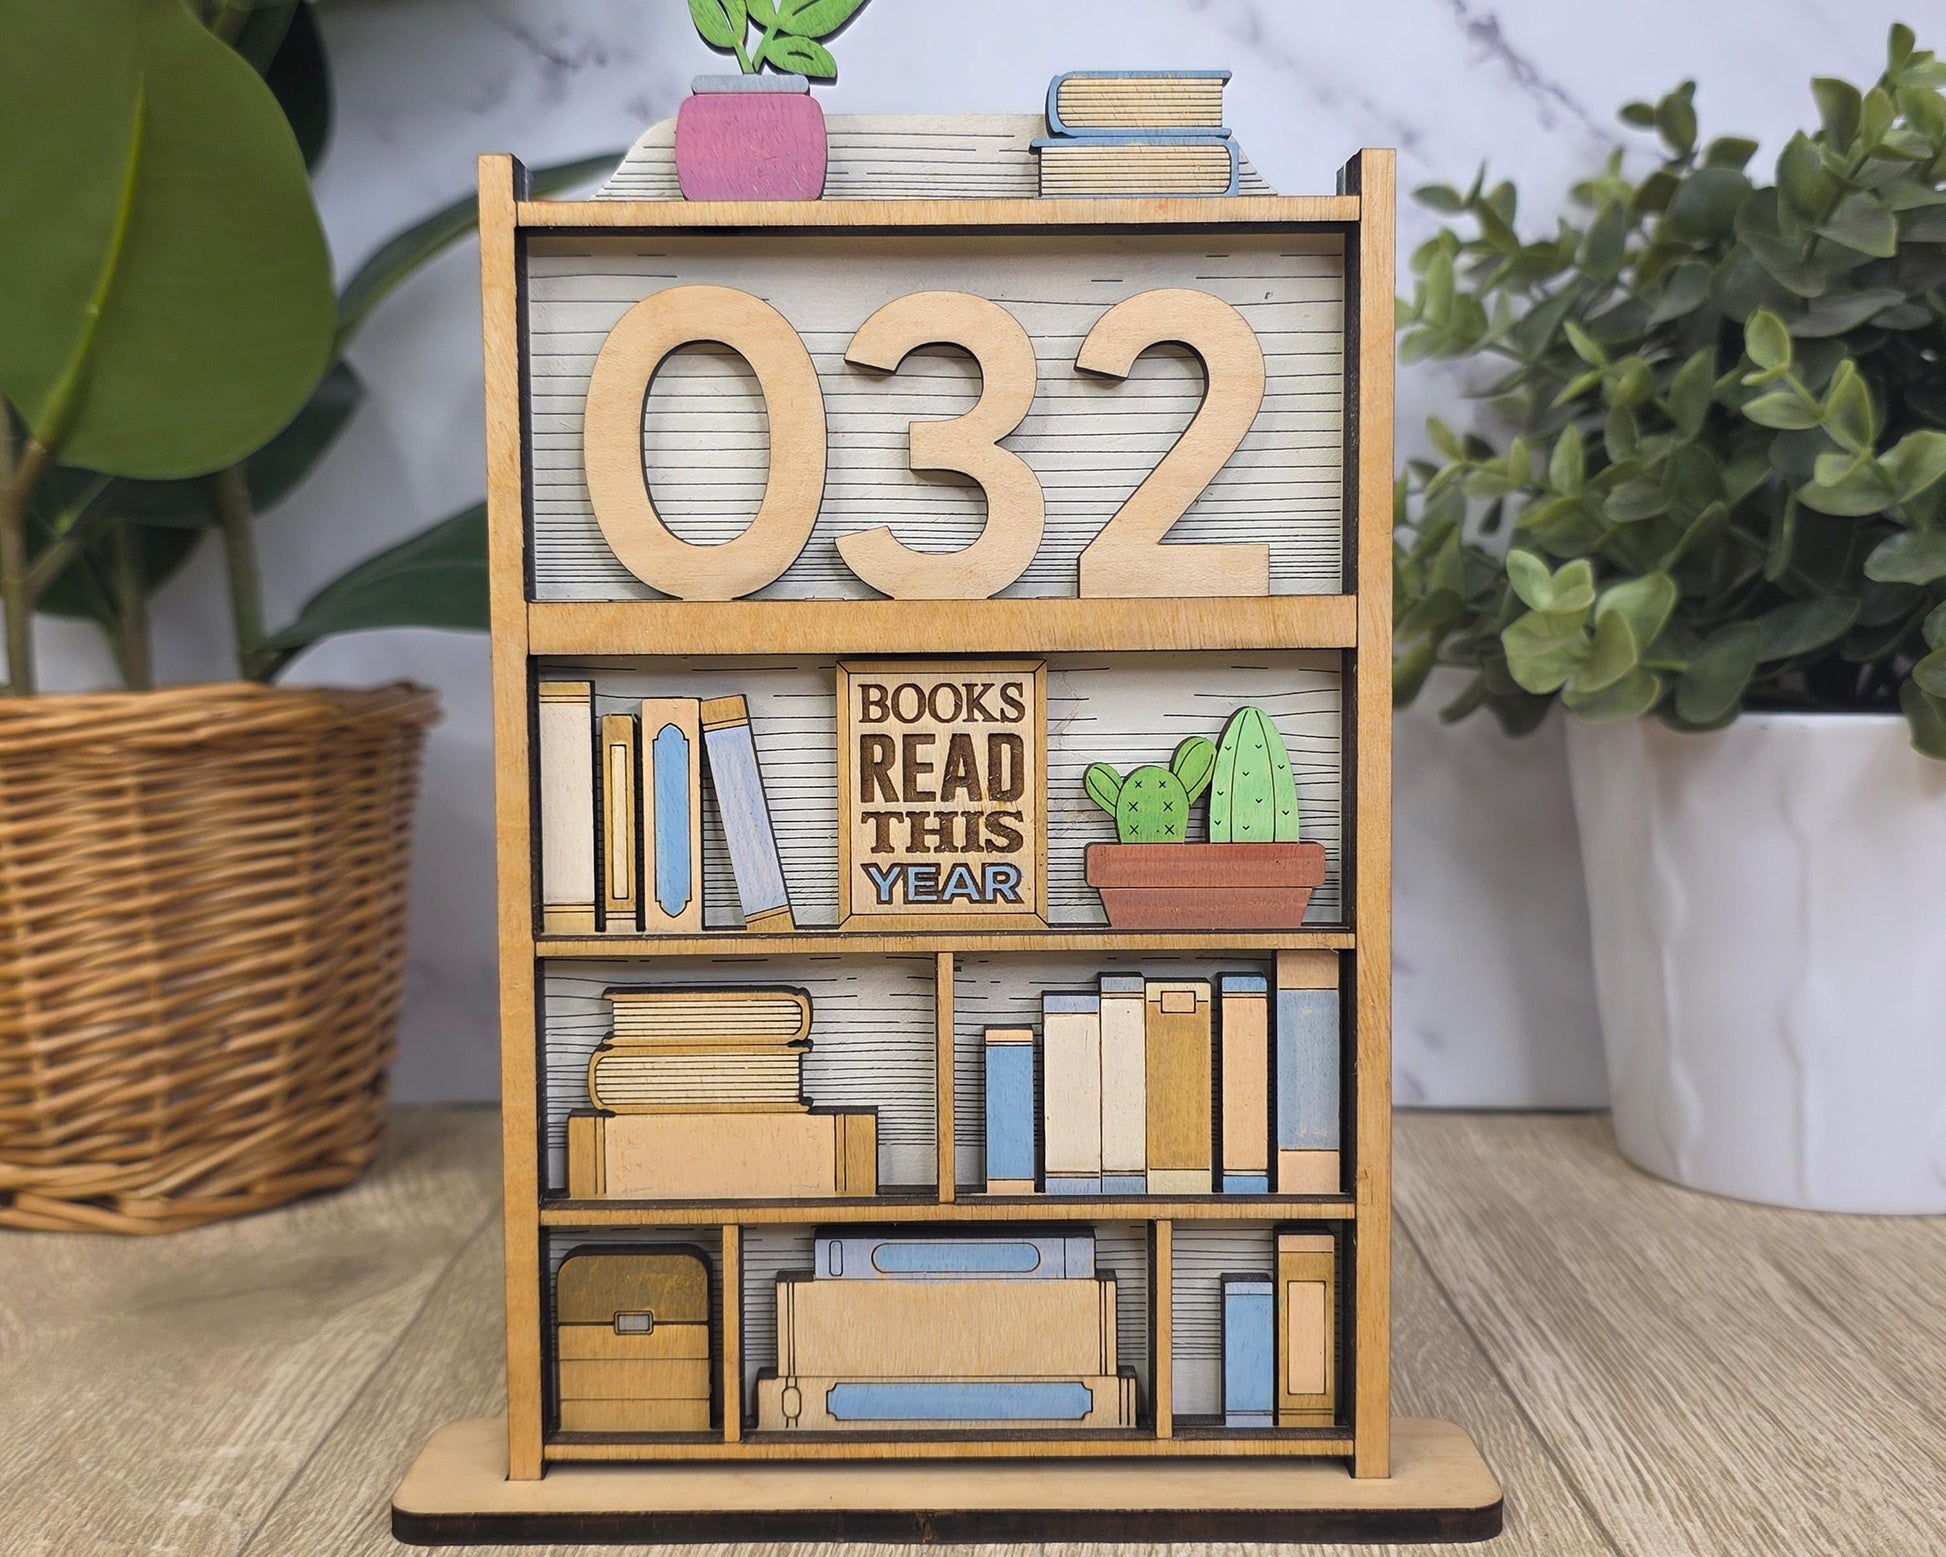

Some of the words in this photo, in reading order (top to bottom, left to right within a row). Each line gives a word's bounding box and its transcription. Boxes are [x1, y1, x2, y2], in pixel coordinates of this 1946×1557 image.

[584, 285, 1270, 600] 032
[857, 682, 1026, 724] BOOKS
[860, 732, 1025, 803] READ
[860, 810, 1024, 854] THIS
[860, 862, 1025, 905] YEAR
